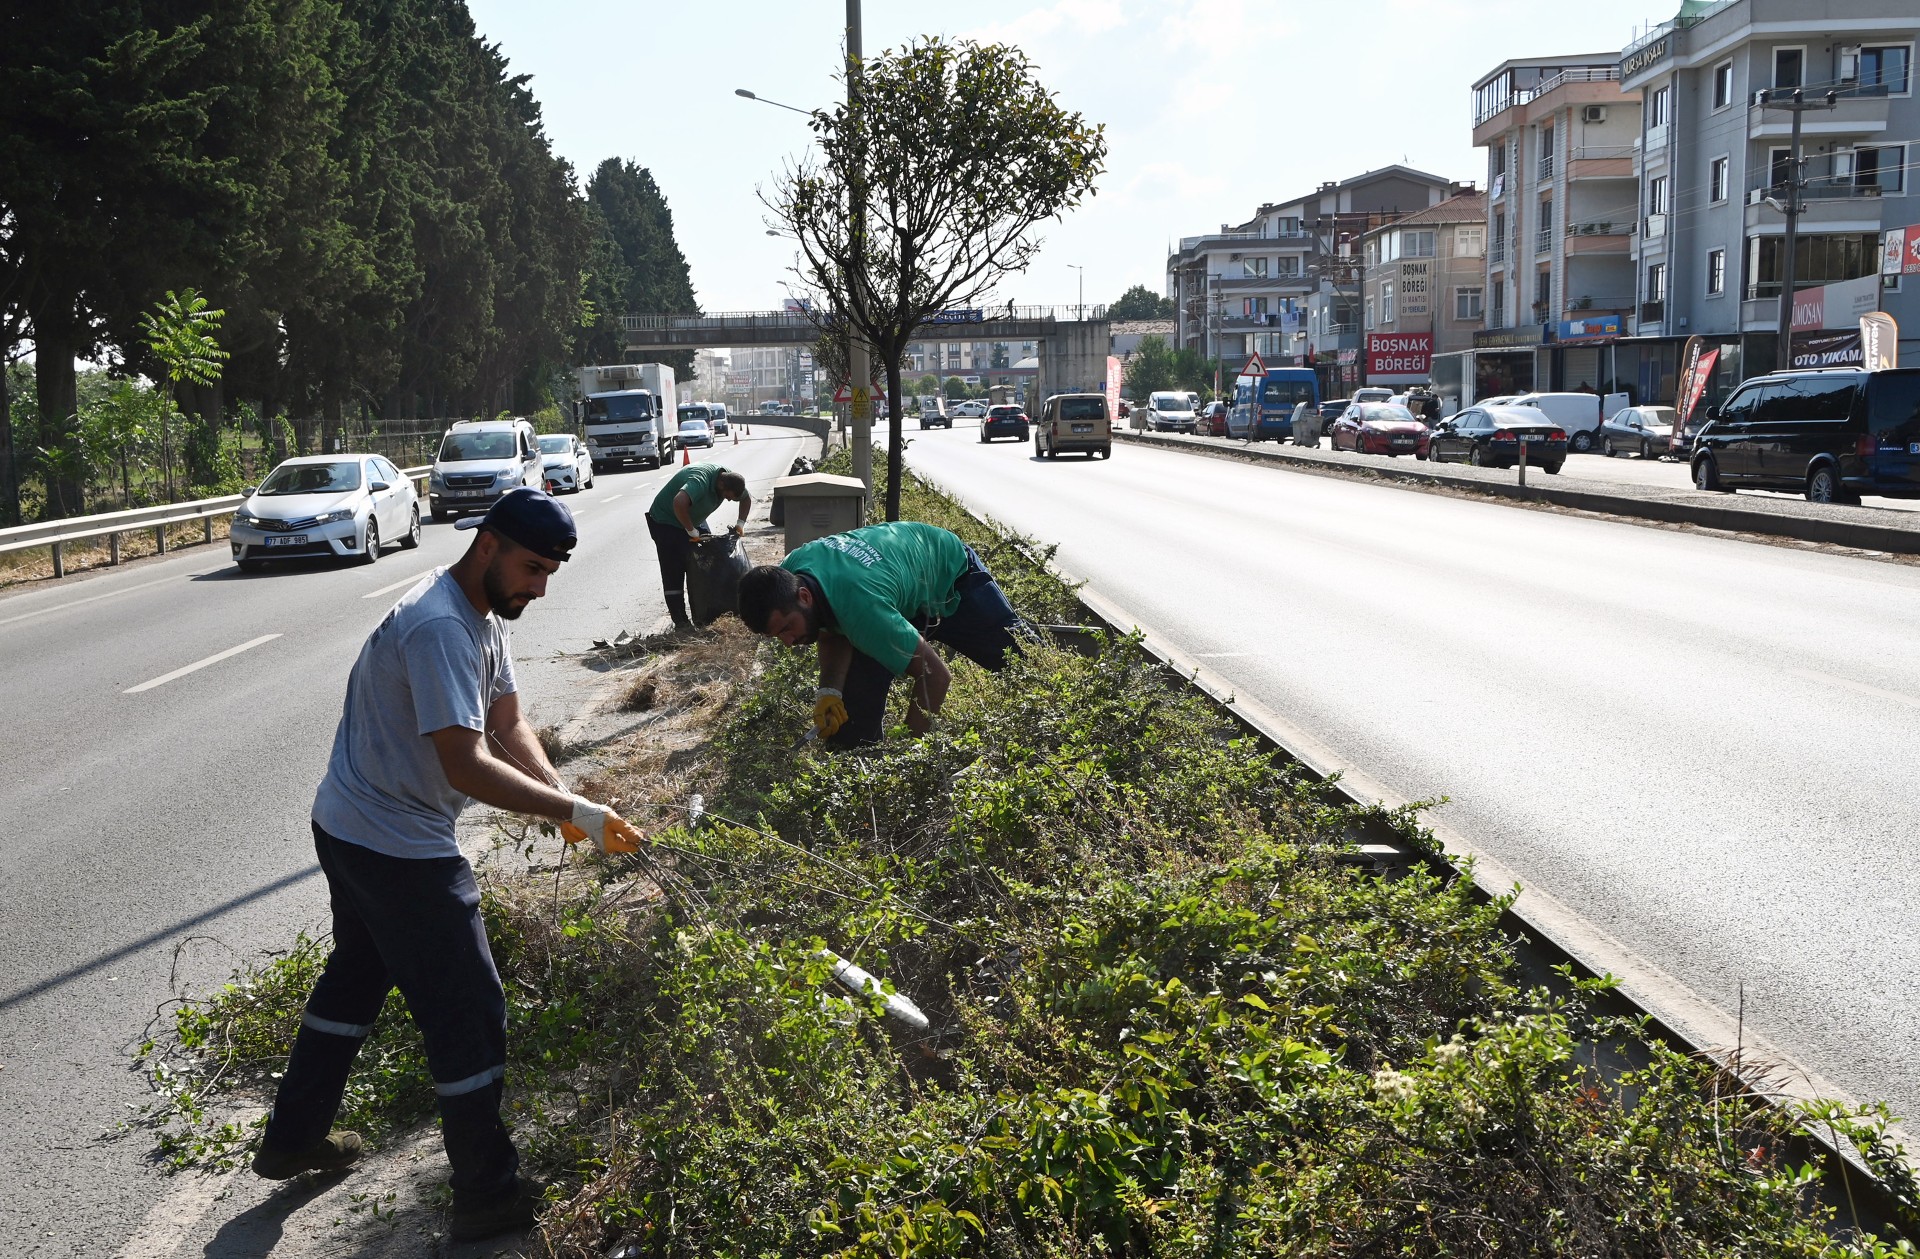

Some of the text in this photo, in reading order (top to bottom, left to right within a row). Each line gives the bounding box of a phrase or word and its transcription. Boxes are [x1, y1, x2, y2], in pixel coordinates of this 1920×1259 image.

[1402, 264, 1427, 278] BOŞNAK
[1402, 278, 1427, 292] BÖREĞİ
[1371, 338, 1429, 355] BOŞNAK
[1375, 355, 1425, 371] BÖREĞİ
[1794, 353, 1818, 366] OTO
[848, 545, 875, 567] YALOVA
[865, 544, 883, 562] PARK
